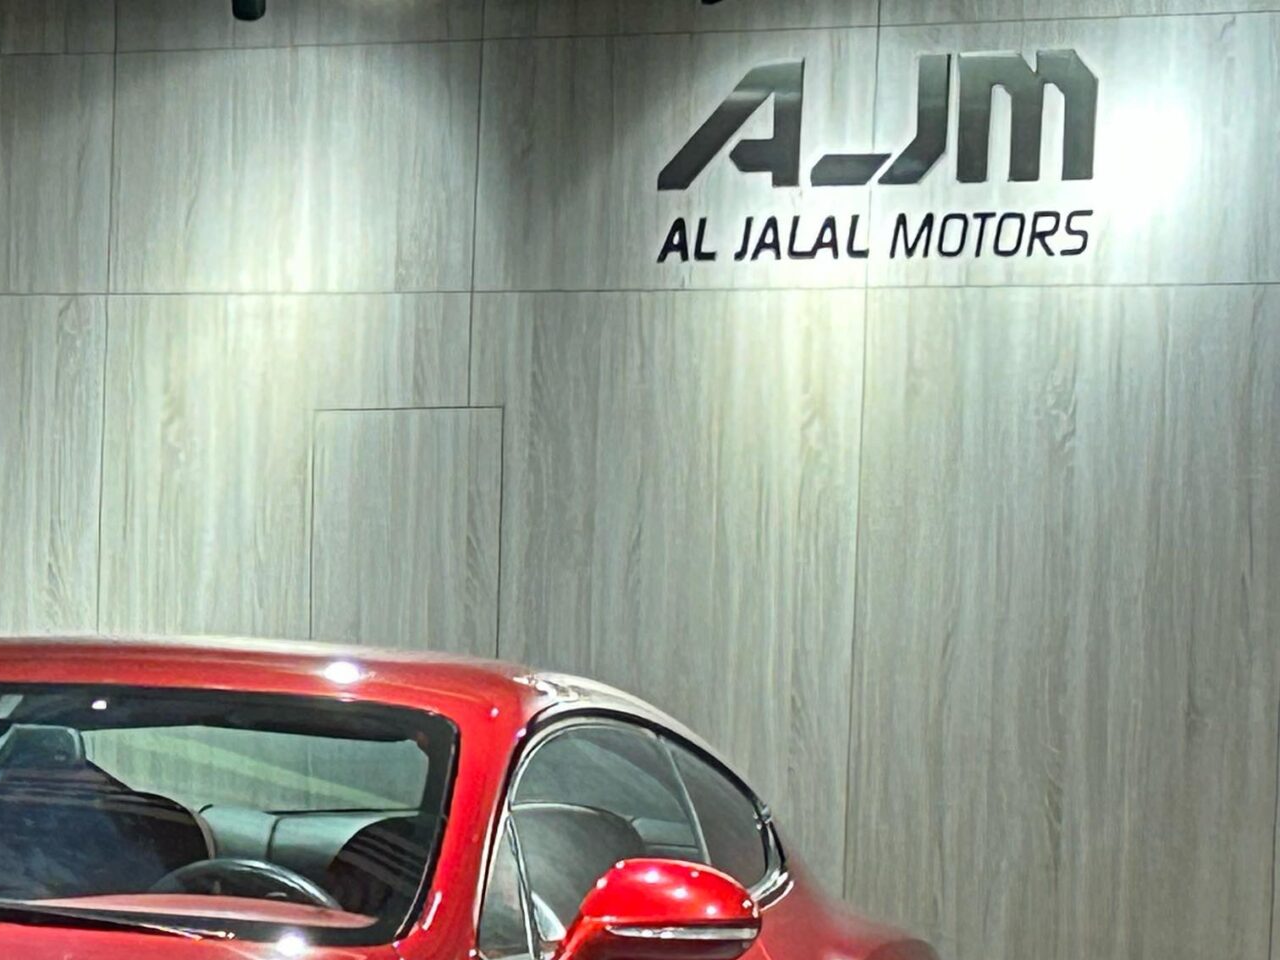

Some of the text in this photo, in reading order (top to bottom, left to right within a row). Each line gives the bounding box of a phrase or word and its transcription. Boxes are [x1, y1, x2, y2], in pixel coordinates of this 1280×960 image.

[657, 48, 1099, 191] AJM
[657, 209, 1094, 263] AL JALAL MOTORS
